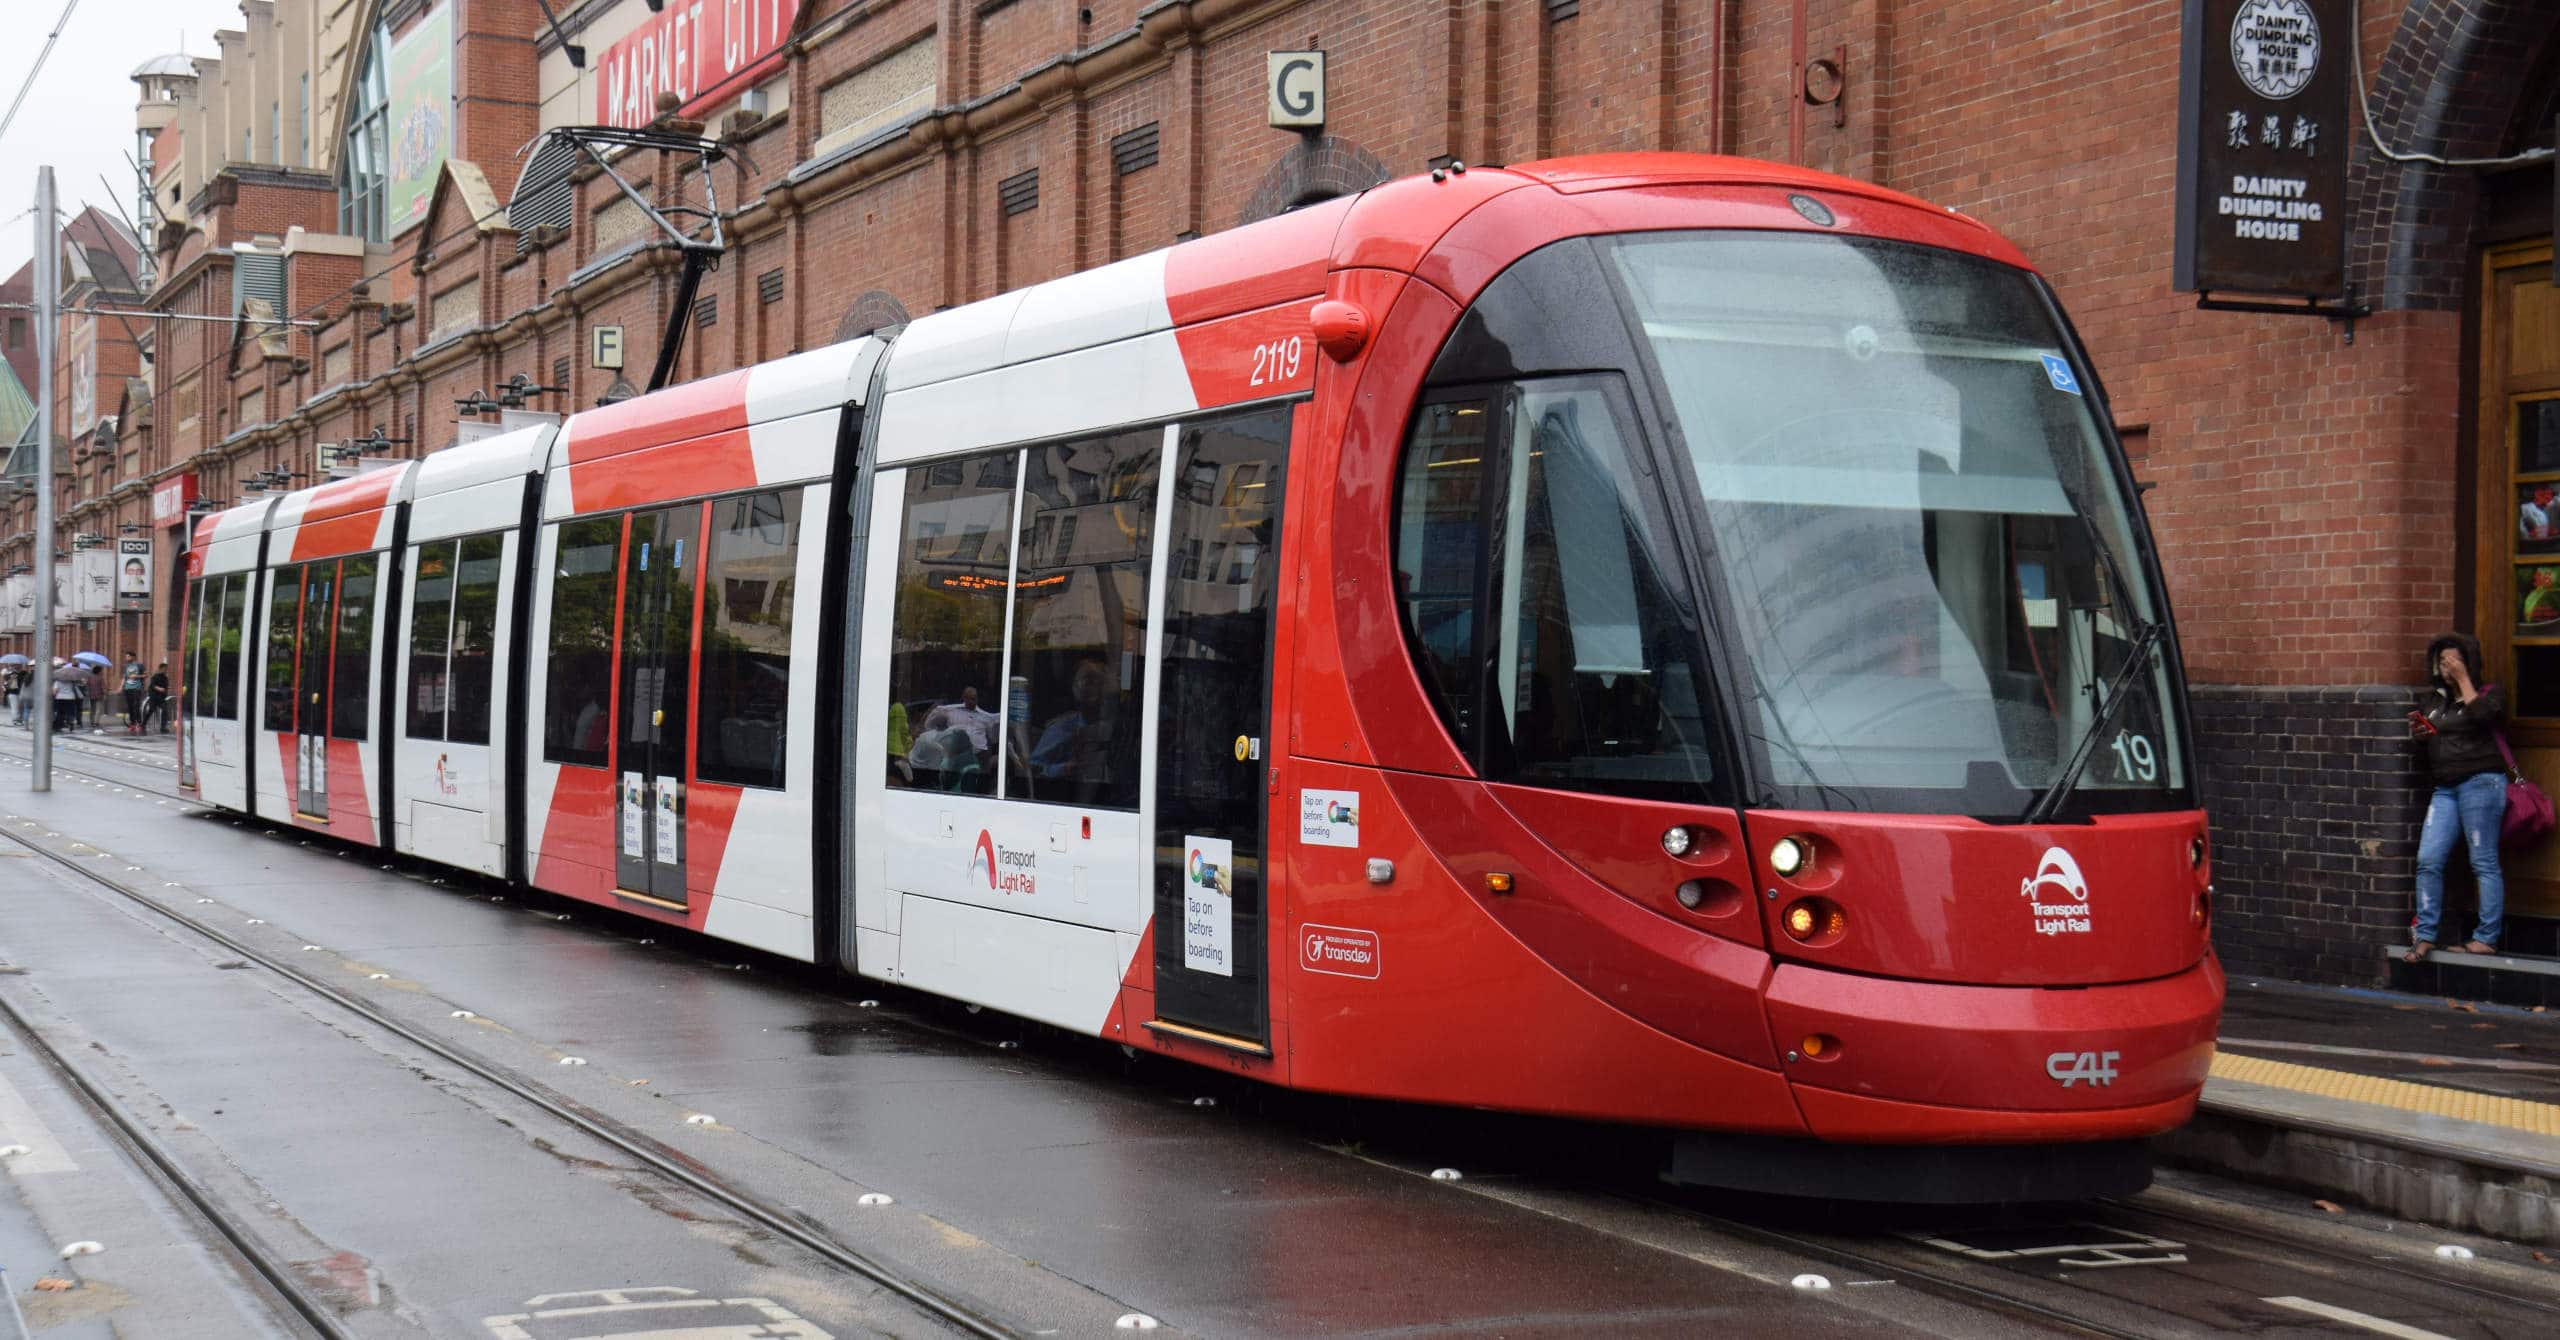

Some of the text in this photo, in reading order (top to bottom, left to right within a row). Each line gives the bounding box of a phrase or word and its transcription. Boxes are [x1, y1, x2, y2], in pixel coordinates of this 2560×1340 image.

[2257, 15, 2302, 30] DAINTY
[2246, 28, 2313, 46] DUMPLING
[2258, 44, 2298, 59] HOUSE
[609, 3, 702, 129] MARKET
[1277, 59, 1315, 116] G
[2233, 175, 2307, 198] DAINTY
[2219, 196, 2322, 221] DUMPLING
[2235, 219, 2300, 241] HOUSE
[599, 330, 617, 363] F
[1250, 335, 1301, 386] 2119
[2111, 735, 2156, 781] 19
[997, 844, 1036, 871] Transport
[999, 869, 1035, 895] Light Rail
[1188, 897, 1213, 917] Tap on
[2030, 902, 2089, 918] Transport
[1188, 917, 1213, 937] before
[2035, 918, 2091, 936] Light Rail
[1188, 940, 1223, 965] boarding
[1324, 943, 1372, 963] transdev
[2046, 1051, 2121, 1088] CAF
